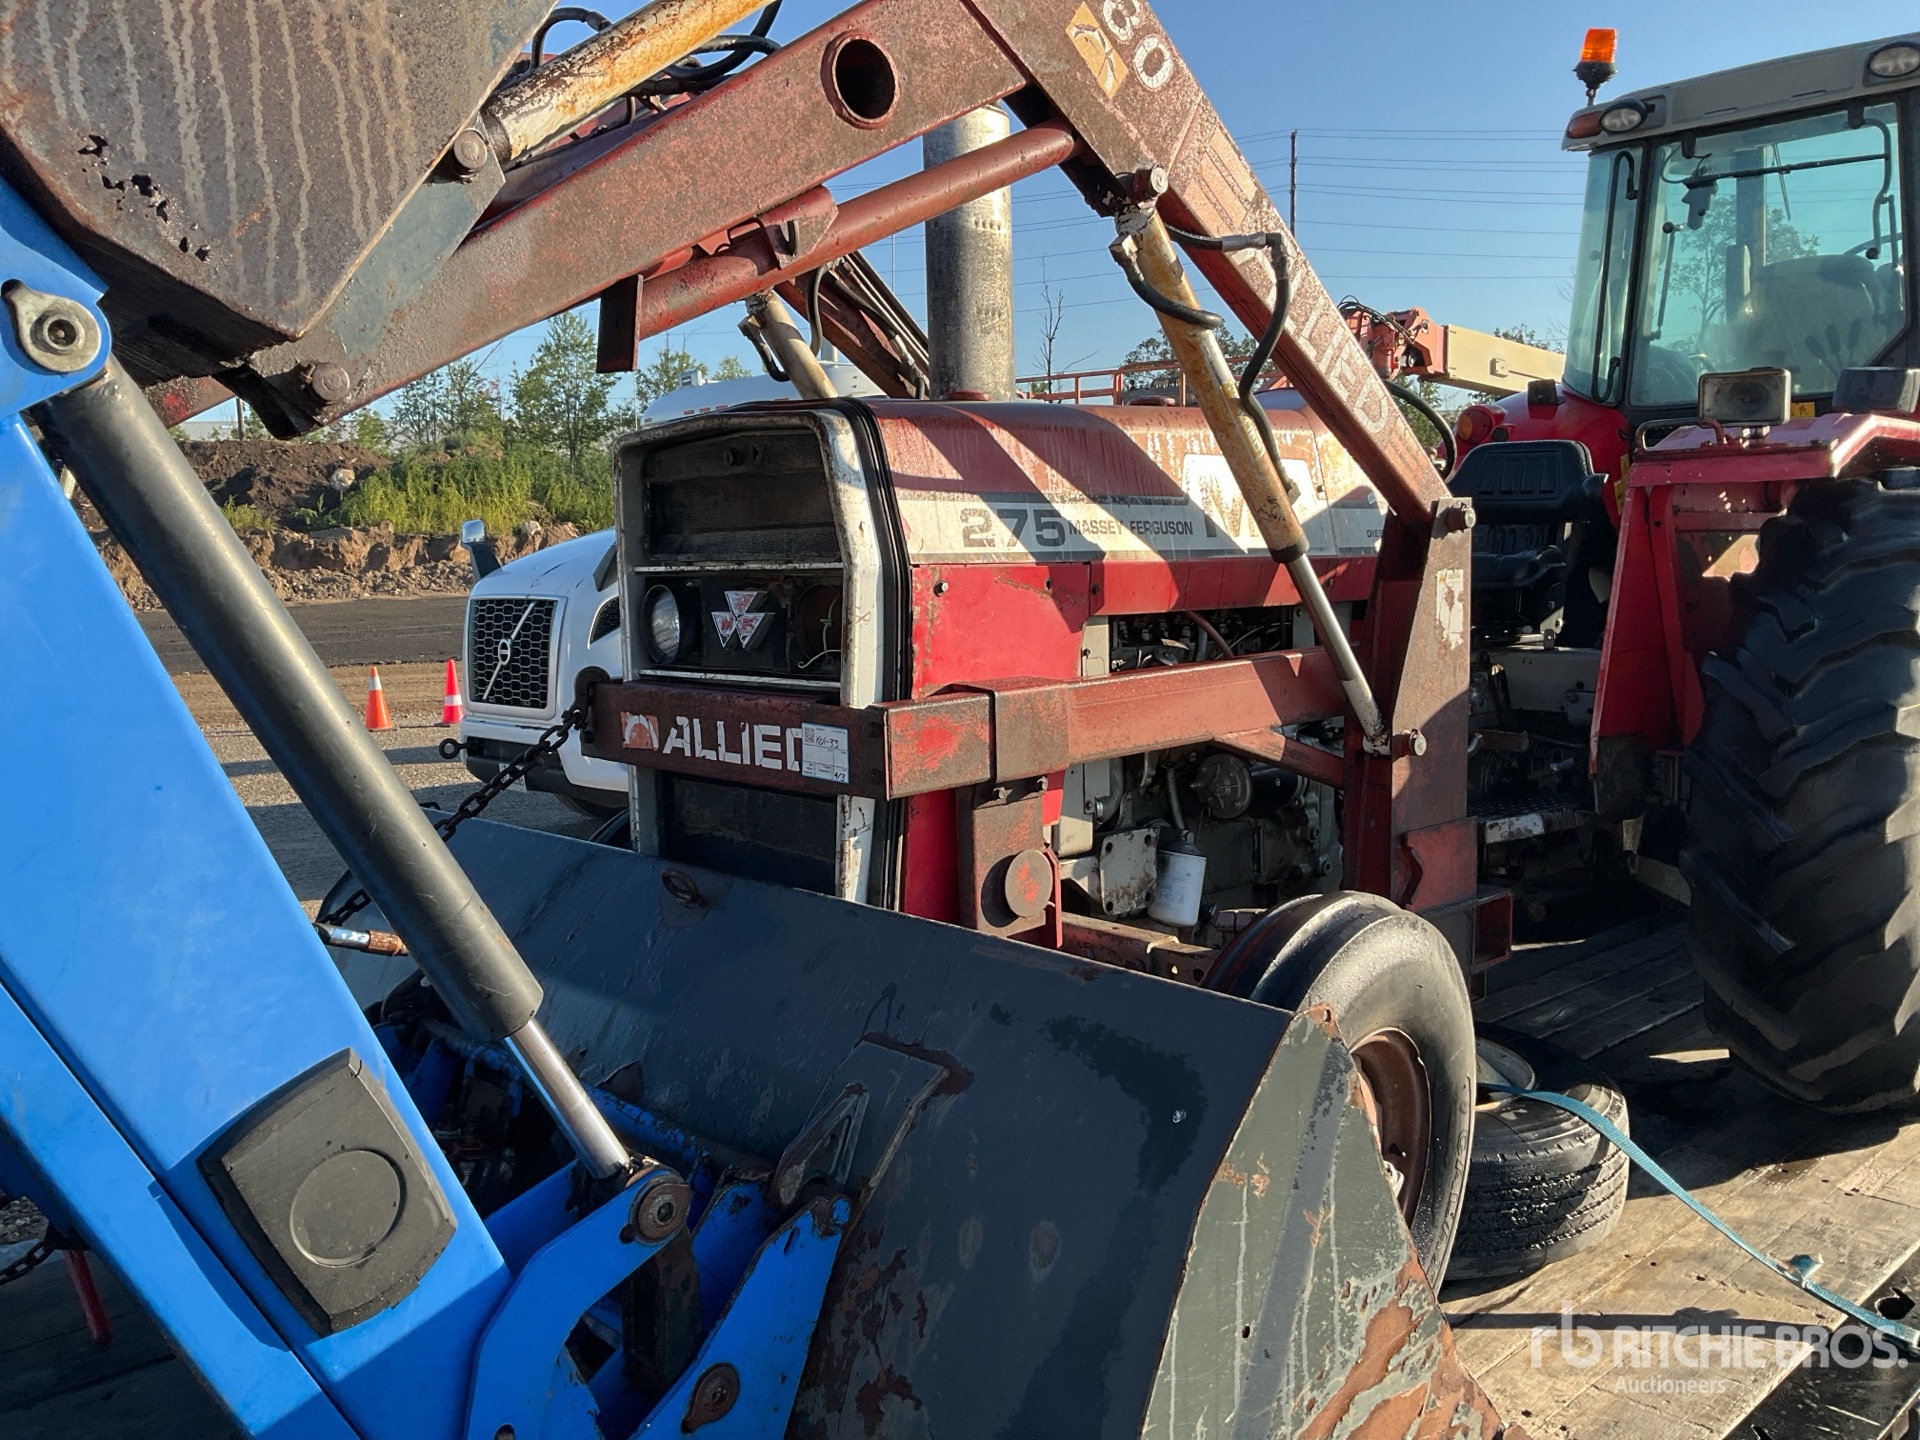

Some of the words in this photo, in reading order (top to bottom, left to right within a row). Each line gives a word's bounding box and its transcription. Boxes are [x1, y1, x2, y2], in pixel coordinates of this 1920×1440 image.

[959, 508, 1066, 547] 275
[1069, 519, 1123, 535] MASSEY
[1130, 520, 1193, 535] FERGUSON
[1366, 529, 1383, 538] DIES
